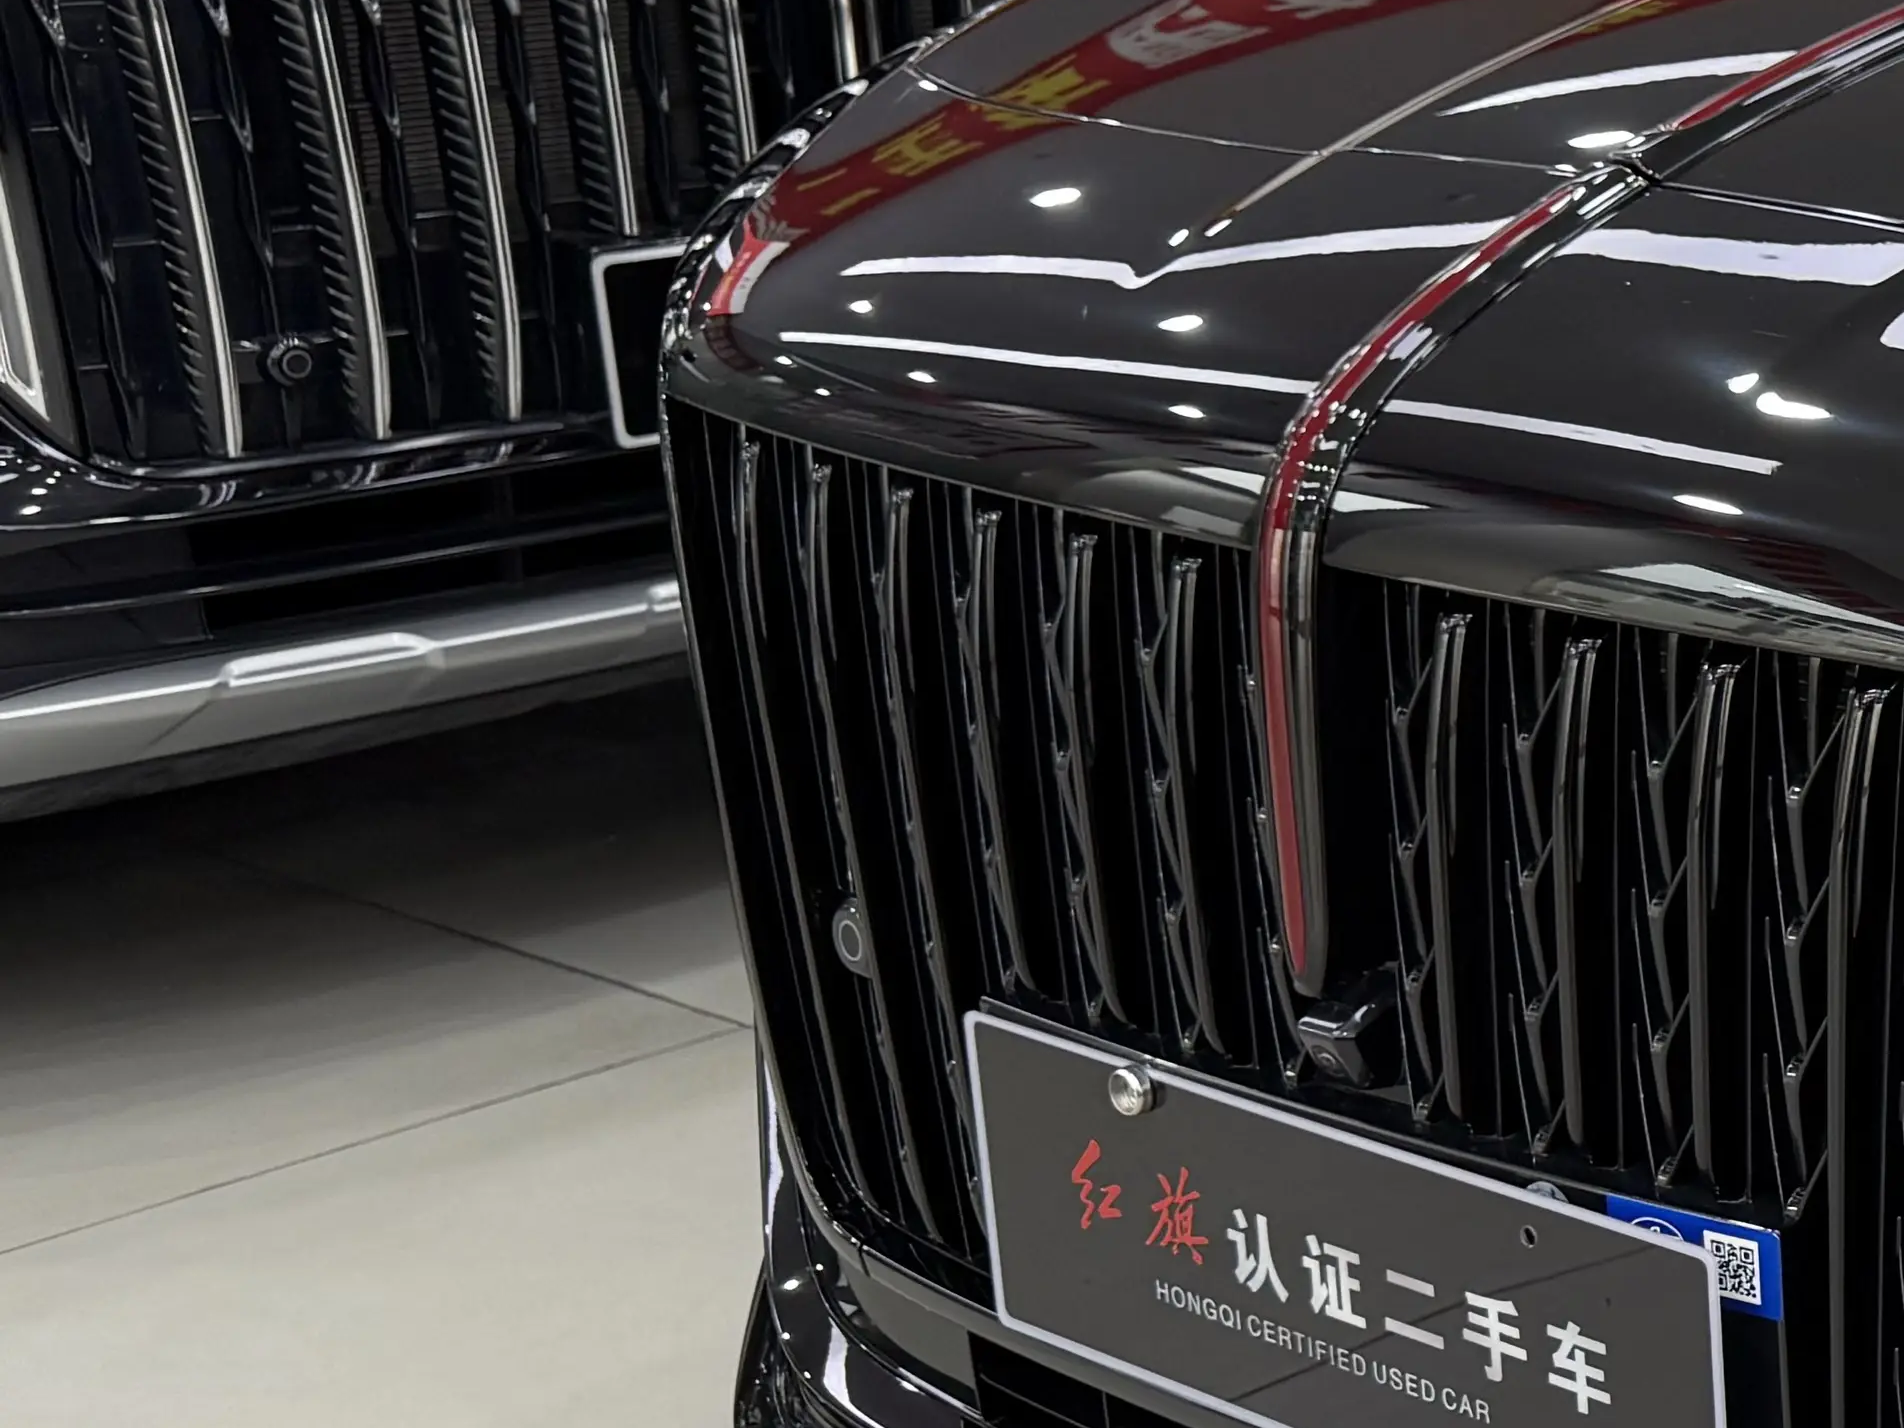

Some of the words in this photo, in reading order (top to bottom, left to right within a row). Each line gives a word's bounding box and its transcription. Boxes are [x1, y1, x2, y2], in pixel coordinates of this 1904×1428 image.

[1155, 1279, 1241, 1330] HONGQI
[1247, 1315, 1366, 1376] CERTIFIED
[1372, 1361, 1435, 1402] USED
[1442, 1388, 1490, 1424] CAR
